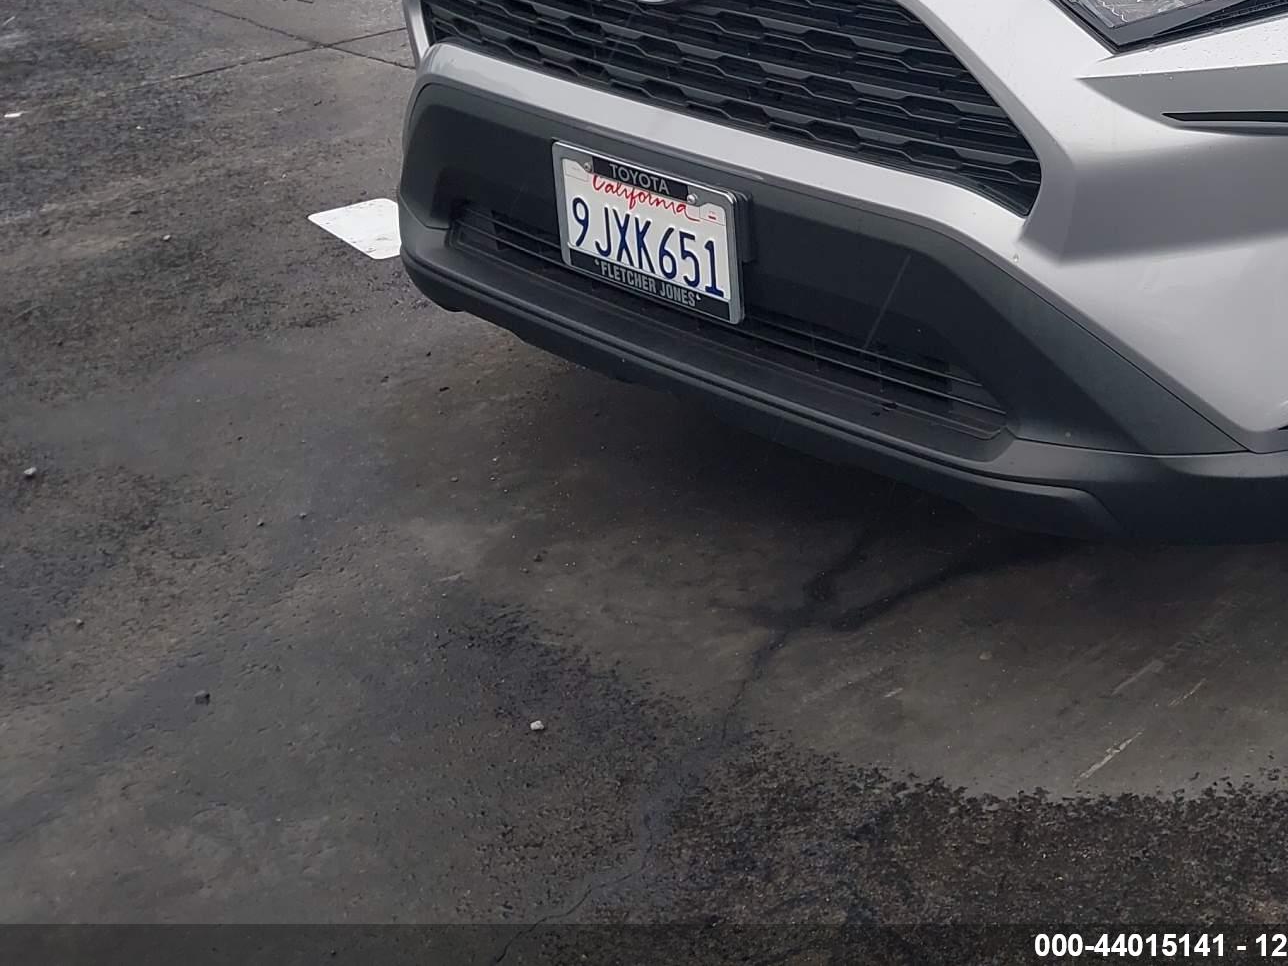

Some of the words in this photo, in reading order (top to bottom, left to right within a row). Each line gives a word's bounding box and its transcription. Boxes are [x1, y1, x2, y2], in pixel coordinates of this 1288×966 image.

[592, 175, 700, 221] California
[609, 163, 670, 195] TOYOTA
[572, 197, 724, 298] 9JXK651
[601, 262, 656, 294] FLETCHER
[660, 285, 696, 307] JONES
